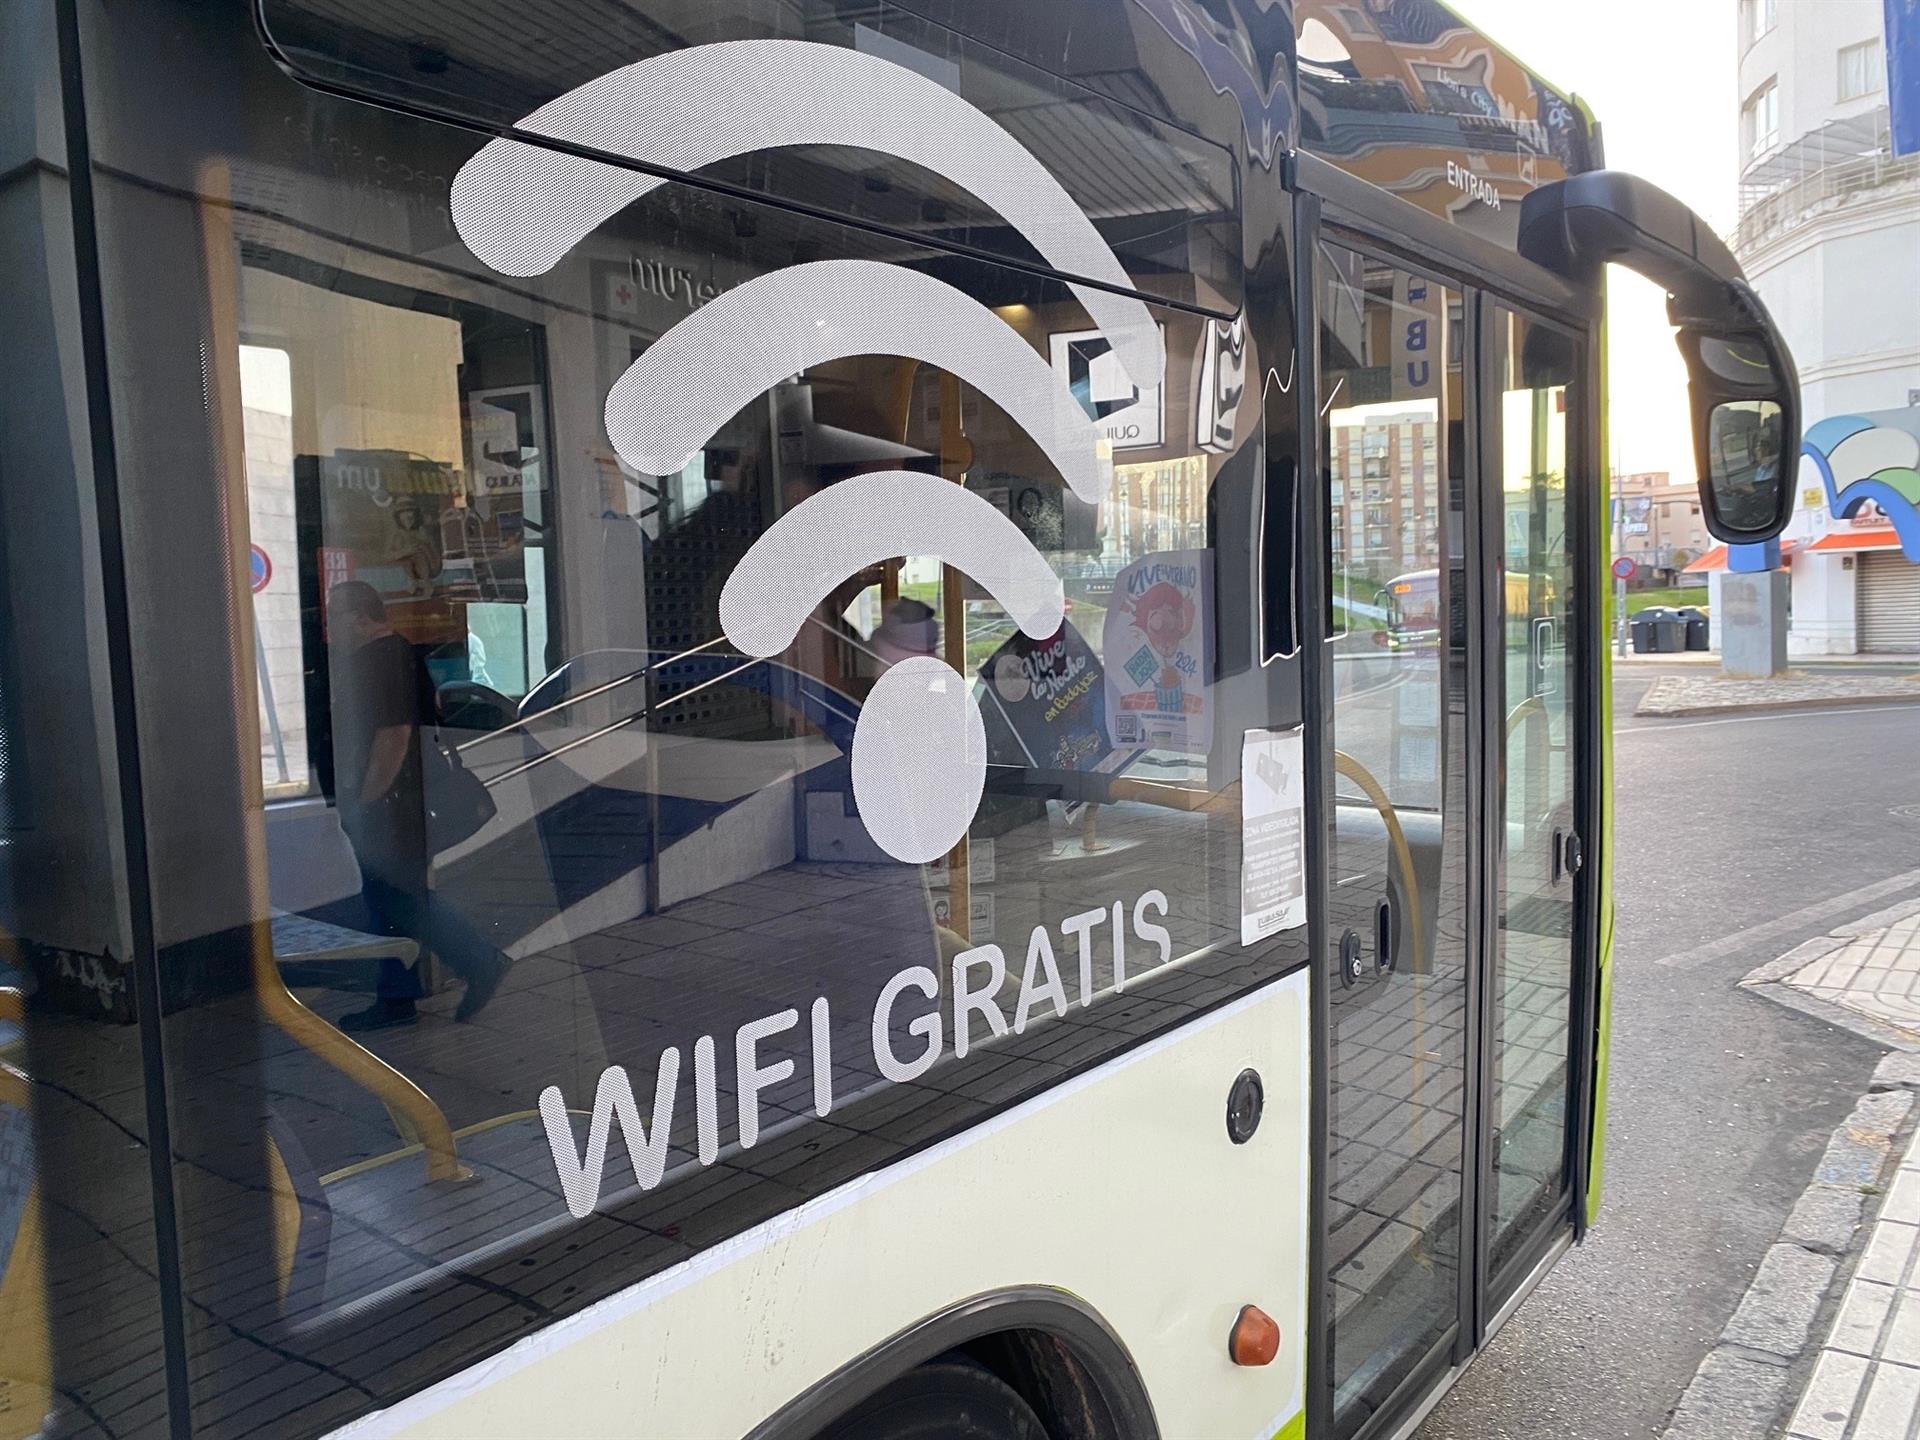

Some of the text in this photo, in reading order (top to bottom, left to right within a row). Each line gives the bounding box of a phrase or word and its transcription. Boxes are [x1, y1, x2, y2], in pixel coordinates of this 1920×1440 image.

[1498, 94, 1549, 154] MAN
[1447, 160, 1501, 211] ENTRADA
[1128, 564, 1161, 593] VIVE
[1020, 640, 1065, 682] Vive
[1031, 656, 1086, 701] la Noche
[1044, 707, 1060, 722] en
[1054, 671, 1098, 709] Badajoz
[538, 889, 1173, 1218] WIFI GRATIS
